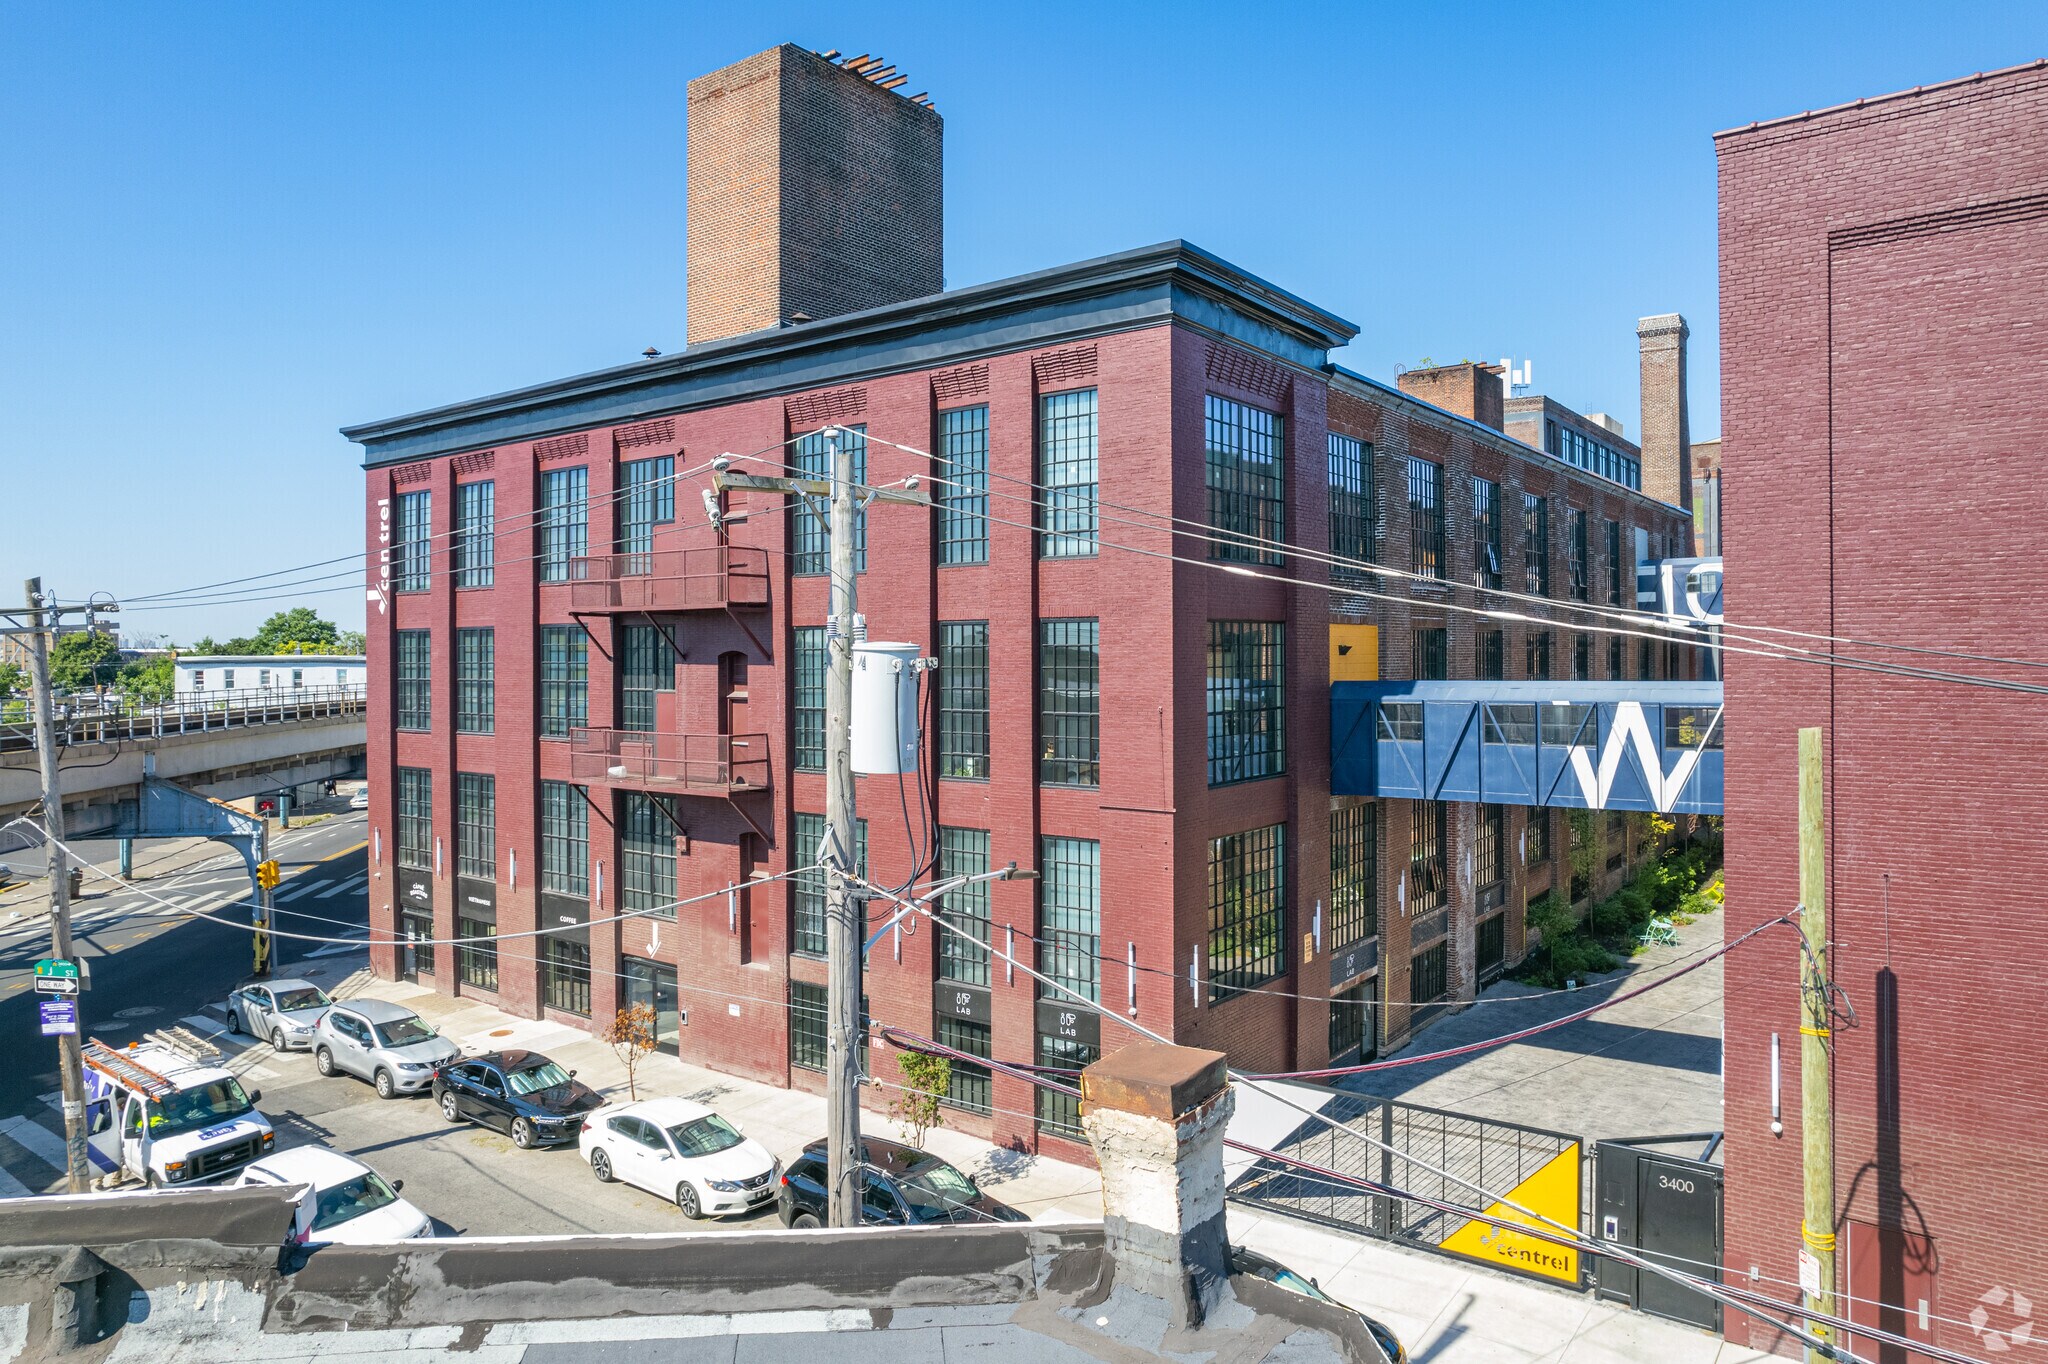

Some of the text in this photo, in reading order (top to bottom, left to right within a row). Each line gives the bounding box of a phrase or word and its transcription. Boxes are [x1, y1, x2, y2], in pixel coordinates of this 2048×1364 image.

[378, 499, 389, 591] centrel
[560, 915, 577, 924] COFFEE
[47, 967, 74, 977] J ST
[1346, 967, 1355, 977] LAB
[39, 980, 51, 988] ONE
[956, 1006, 971, 1016] LAB
[1060, 1026, 1076, 1037] LAB
[1659, 1175, 1694, 1193] 3400
[1496, 1244, 1568, 1271] centrel
